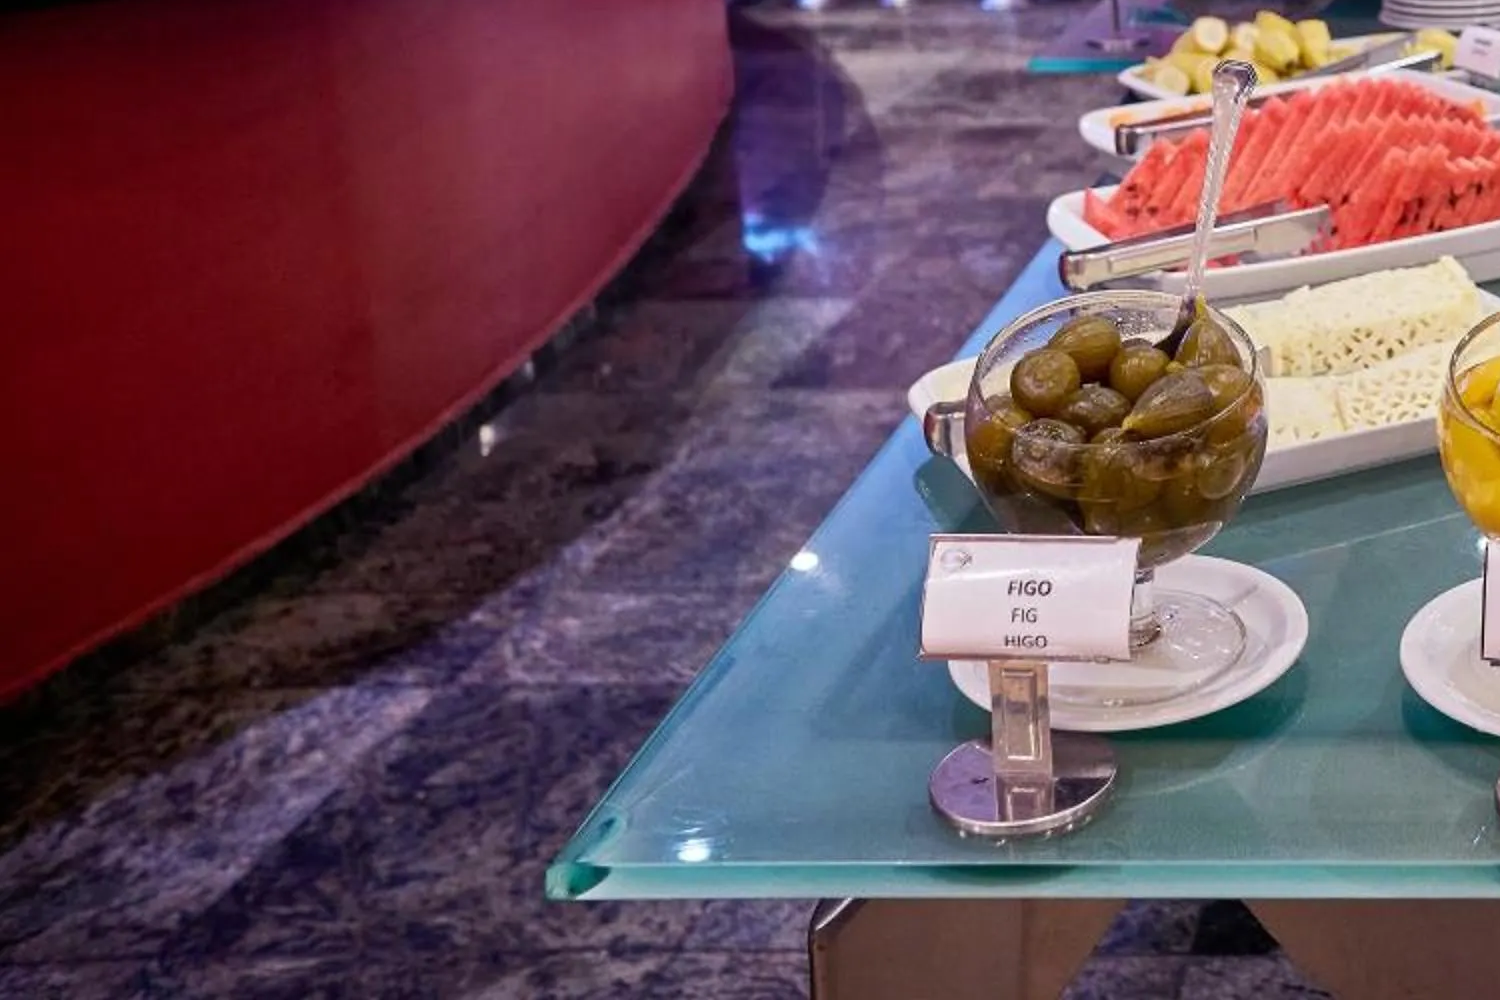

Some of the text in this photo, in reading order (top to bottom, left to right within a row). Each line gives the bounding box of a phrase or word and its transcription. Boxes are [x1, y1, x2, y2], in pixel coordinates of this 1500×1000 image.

[1007, 579, 1054, 597] FIGO
[1010, 607, 1038, 624] FIG
[1004, 634, 1049, 649] HIGO
